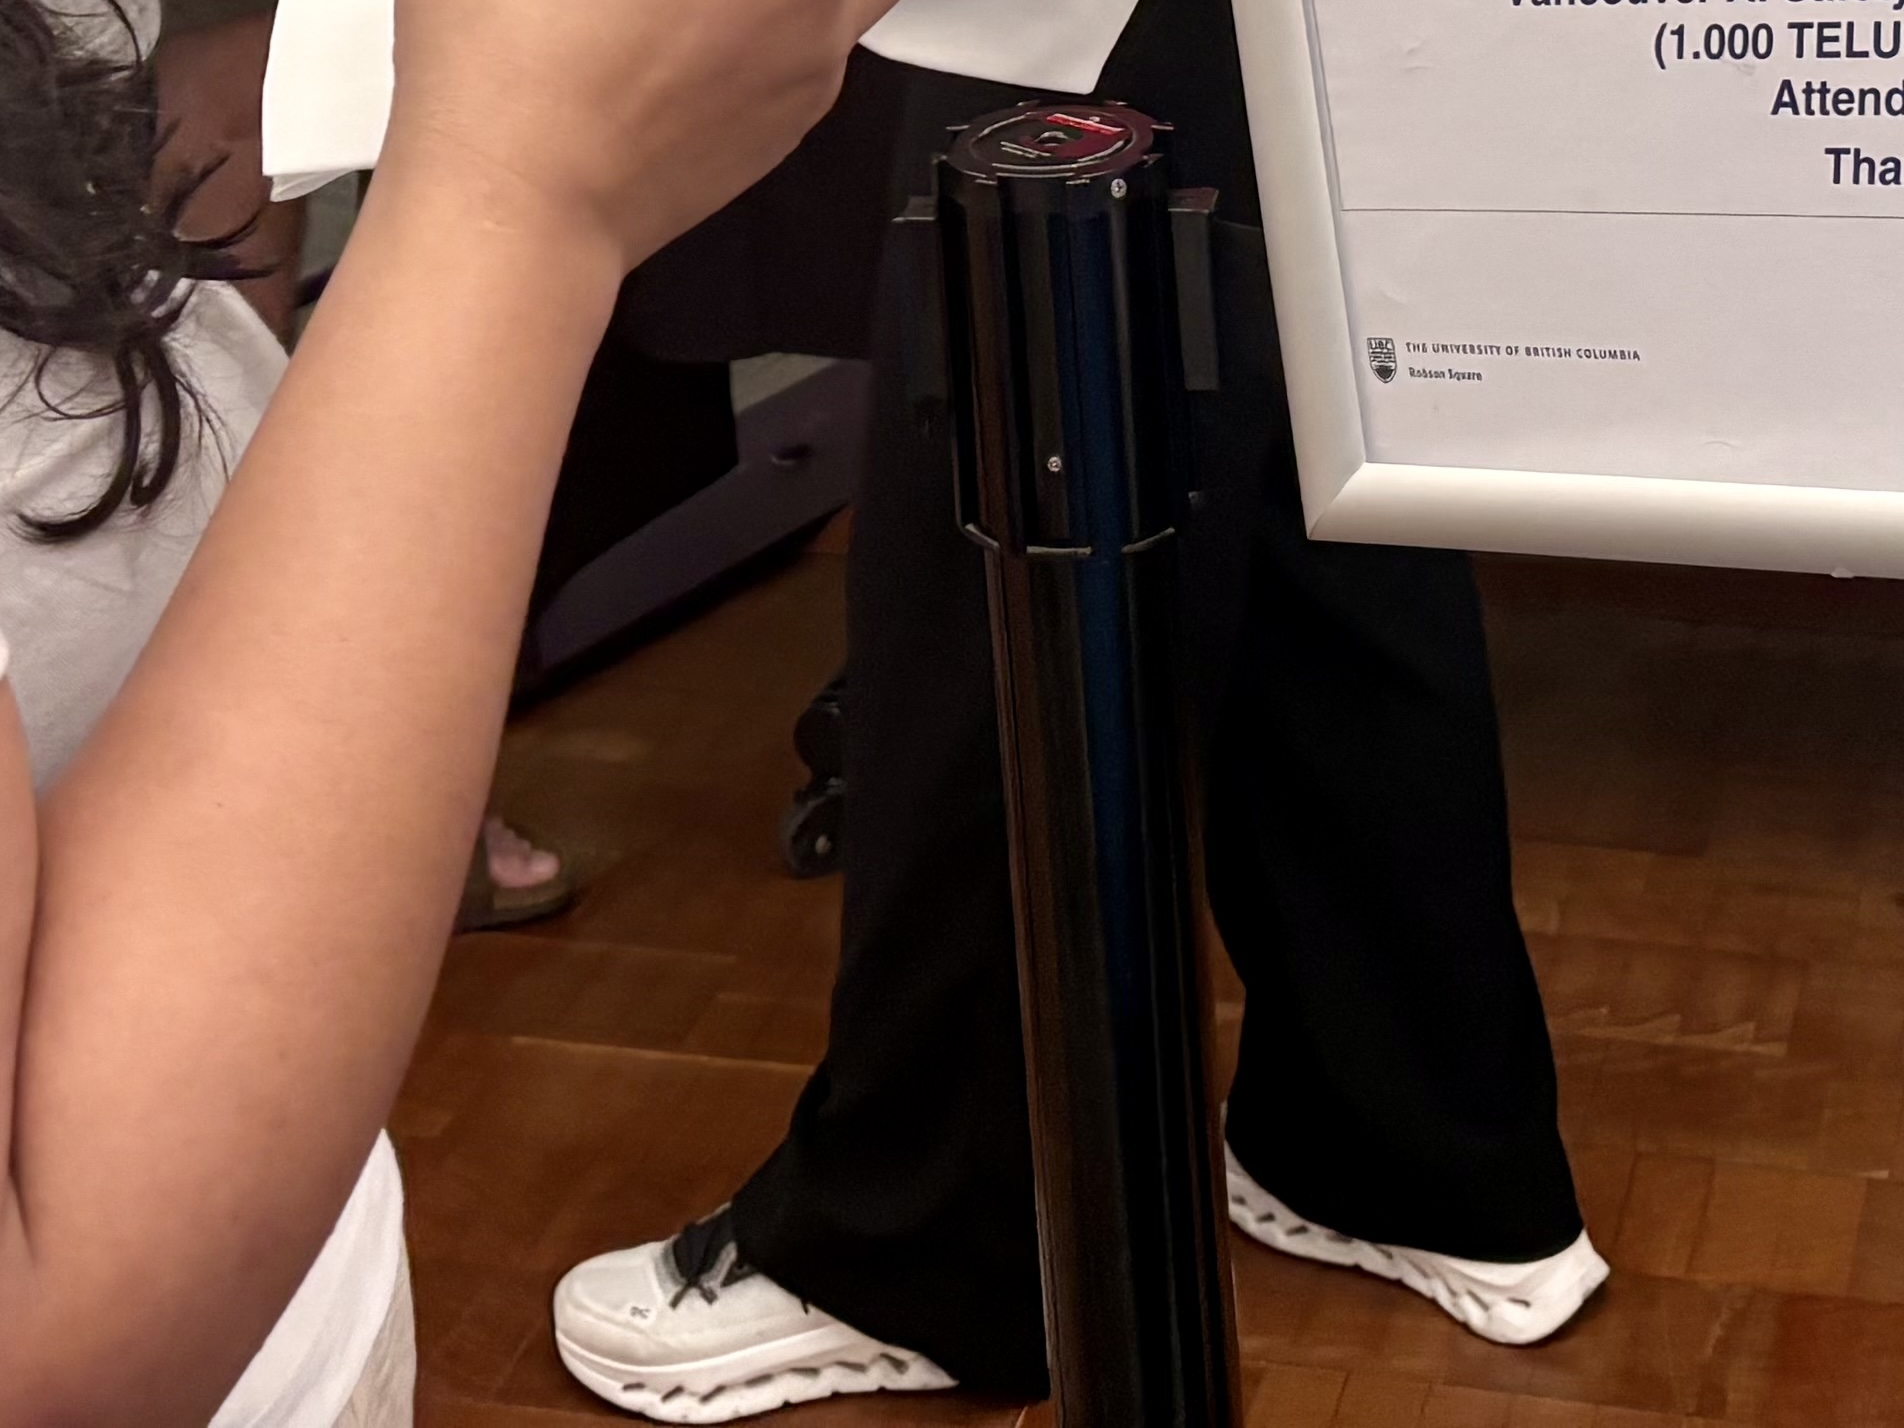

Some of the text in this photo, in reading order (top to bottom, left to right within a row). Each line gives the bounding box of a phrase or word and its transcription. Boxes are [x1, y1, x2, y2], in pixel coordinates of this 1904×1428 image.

[1653, 21, 1775, 70] (1.000
[1405, 341, 1641, 361] THE UNIVERSITY OF BRITISH COLUMBIA
[1408, 366, 1483, 381] Robson Square
